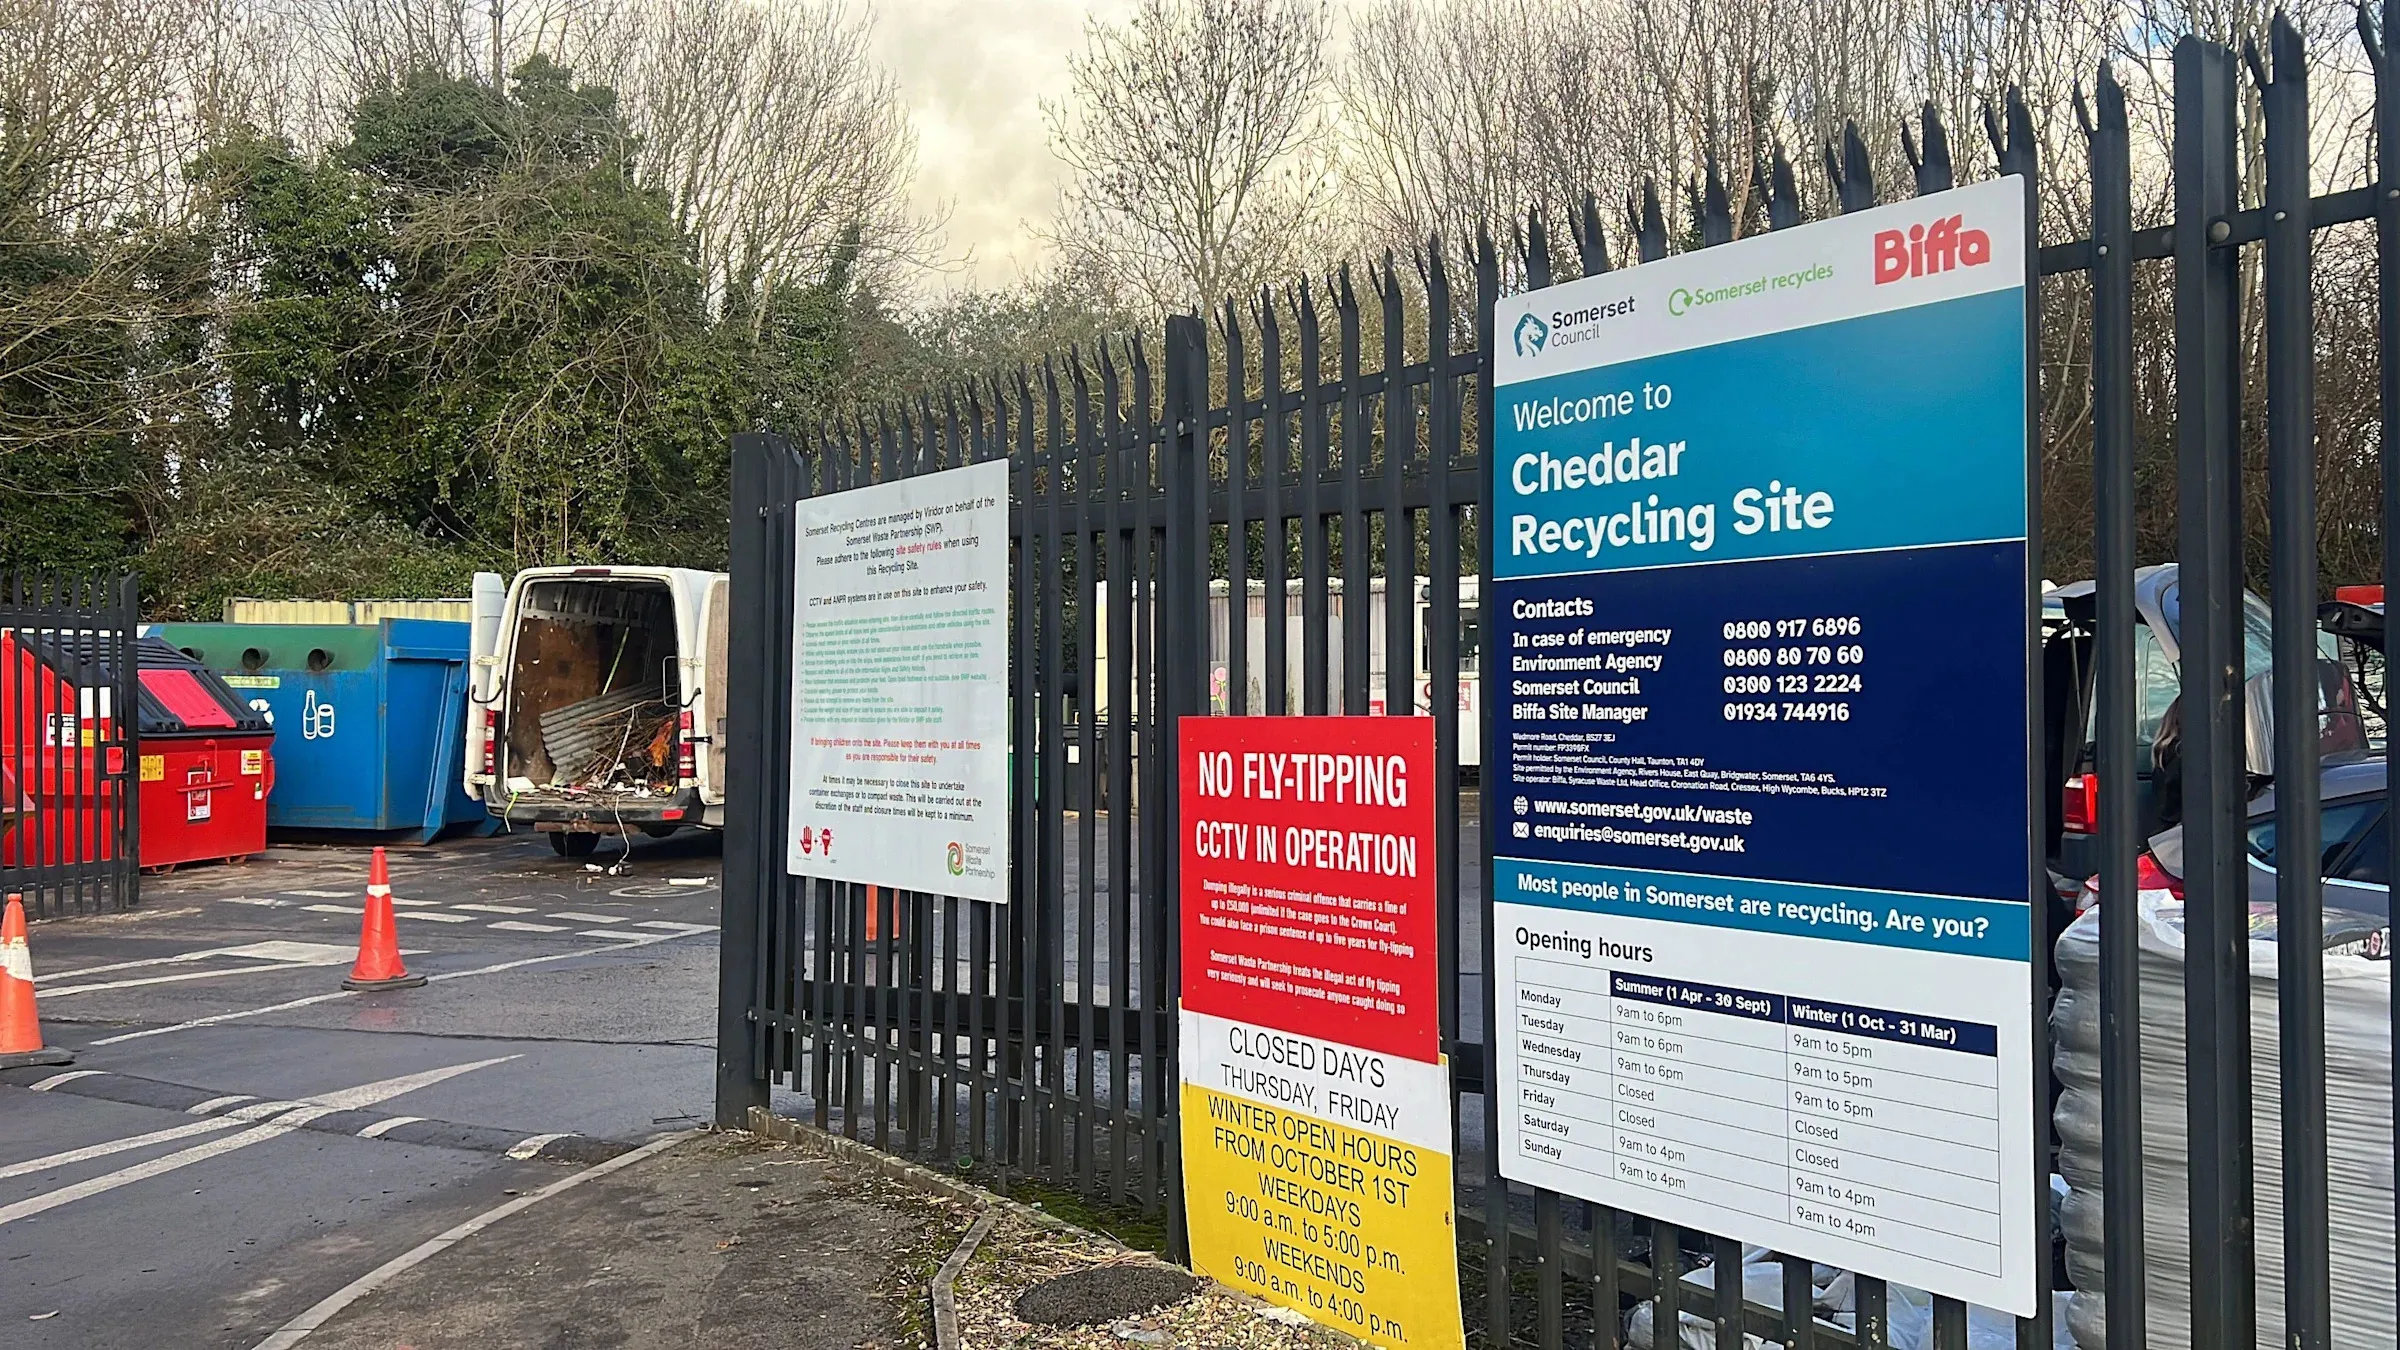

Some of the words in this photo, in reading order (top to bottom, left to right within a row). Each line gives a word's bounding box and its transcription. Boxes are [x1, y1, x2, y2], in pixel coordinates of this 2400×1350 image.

[1875, 214, 1990, 285] Biffa
[1695, 276, 1766, 305] Somerset
[1772, 263, 1833, 289] recycles
[1552, 296, 1634, 329] Somerset
[1551, 323, 1599, 347] Council
[1513, 391, 1633, 431] Welcome
[1643, 382, 1671, 410] to
[1512, 438, 1684, 494] Cheddar
[805, 525, 828, 537] Somerset
[830, 521, 854, 533] Recycling
[855, 518, 877, 528] Centres
[877, 516, 888, 525] are
[888, 510, 913, 523] managed
[913, 509, 922, 520] by
[923, 506, 945, 517] Viridor
[945, 505, 954, 514] on
[955, 498, 974, 512] behalf
[976, 497, 984, 508] of
[984, 497, 994, 507] the
[1512, 495, 1714, 557] Recycling
[1733, 480, 1833, 534] Site
[1512, 597, 1593, 619] Contacts
[1512, 632, 1528, 647] In
[1531, 633, 1564, 647] case
[1568, 628, 1584, 645] of
[1587, 629, 1671, 647] emergency
[1723, 621, 1771, 639] 0800
[1776, 619, 1806, 637] 917
[1812, 616, 1860, 636] 6896
[1512, 654, 1601, 671] Environment
[1605, 653, 1661, 673] Agency
[1723, 648, 1771, 666] 0800
[1776, 647, 1801, 665] 80
[1806, 646, 1831, 664] 70
[1837, 645, 1863, 664] 60
[1512, 680, 1579, 695] Somerset
[1583, 676, 1639, 694] Council
[1723, 675, 1771, 693] 0300
[1776, 675, 1807, 693] 123
[1814, 674, 1861, 692] 2224
[1512, 702, 1545, 719] Biffa
[1549, 702, 1578, 719] Site
[1582, 703, 1647, 724] Manager
[1723, 703, 1777, 720] 01934
[1782, 703, 1849, 721] 744916
[822, 775, 827, 783] At
[846, 777, 855, 786] may
[856, 777, 862, 785] be
[863, 778, 888, 788] necessary
[910, 779, 920, 788] this
[921, 780, 930, 789] site
[931, 781, 936, 789] to
[938, 782, 964, 791] undertake
[1199, 751, 1232, 797] NO
[1243, 753, 1406, 806] FLY-TIPPING
[1512, 773, 1525, 782] Site
[1568, 775, 1595, 785] Syracuse
[1629, 778, 1647, 787] Head
[1670, 780, 1708, 789] Coronation
[1709, 781, 1729, 791] Road,
[1730, 782, 1761, 792] Cressex,
[1762, 783, 1780, 794] High
[1781, 784, 1820, 795] Wycombe,
[1821, 786, 1847, 796] Bucks,
[1847, 787, 1869, 796] HP12
[1870, 787, 1887, 797] 3TZ
[1534, 801, 1751, 824] www.somerset.gov.uk/waste
[965, 842, 991, 855] Somerset
[1196, 820, 1247, 860] CCTV
[1256, 825, 1276, 863] IN
[1285, 827, 1415, 876] OPERATION
[1534, 823, 1744, 852] enquiries@somerset.gov.uk
[965, 855, 982, 866] Waste
[965, 866, 995, 880] Partnership
[1518, 873, 1557, 893] Most
[1562, 881, 1618, 901] people
[1623, 881, 1640, 902] in
[1646, 886, 1733, 912] Somerset
[1740, 899, 1771, 916] are
[1778, 902, 1878, 931] recycling.
[1885, 909, 1925, 932] Are
[1932, 917, 1988, 938] you?
[1515, 927, 1591, 959] Opening
[1599, 937, 1652, 962] hours
[1210, 949, 1237, 964] Somerset
[1237, 954, 1256, 968] Waste
[1257, 957, 1291, 976] Partnership
[1292, 964, 1311, 978] treats
[1312, 967, 1323, 980] the
[1324, 969, 1344, 985] illegal
[1345, 974, 1356, 986] act
[1357, 975, 1364, 987] of
[1365, 976, 1375, 992] fly
[1376, 978, 1400, 996] tipping
[1521, 989, 1560, 1008] Monday
[1615, 978, 1663, 996] Summer
[1666, 985, 1676, 1001] (1
[1680, 988, 1702, 1004] Apr
[1715, 993, 1732, 1007] 30
[1735, 996, 1770, 1016] Sept)
[1521, 1014, 1563, 1033] Tuesday
[1616, 1004, 1639, 1019] 9am
[1643, 1010, 1654, 1021] to
[1657, 1011, 1682, 1026] 6pm
[1792, 1004, 1838, 1023] Winter
[1841, 1011, 1854, 1028] (1
[1858, 1014, 1885, 1031] Oct
[1899, 1020, 1916, 1036] 31
[1921, 1023, 1956, 1044] Mar)
[1229, 1027, 1314, 1070] CLOSED
[1323, 1047, 1384, 1087] DAYS
[1522, 1039, 1580, 1062] Wednesday
[1793, 1033, 1821, 1049] 9am
[1825, 1039, 1838, 1052] to
[1843, 1041, 1871, 1058] 5pm
[1522, 1064, 1569, 1085] Thursday
[1221, 1063, 1316, 1112] THURSDAY,
[1329, 1091, 1398, 1130] FRIDAY
[1523, 1089, 1554, 1107] Friday
[1208, 1095, 1276, 1135] WINTER
[1283, 1116, 1335, 1153] OPEN
[1342, 1132, 1416, 1176] HOURS
[1524, 1114, 1569, 1136] Saturday
[1524, 1139, 1561, 1159] Sunday
[1215, 1126, 1264, 1163] FROM
[1271, 1144, 1364, 1195] OCTOBER
[1373, 1175, 1409, 1208] 1ST
[1258, 1172, 1360, 1227] WEEKDAYS
[1226, 1191, 1258, 1221] 9:00
[1264, 1209, 1297, 1235] a.m.
[1302, 1217, 1317, 1242] to
[1324, 1224, 1359, 1257] 5:00
[1366, 1245, 1404, 1274] p.m.
[1263, 1236, 1364, 1293] WEEKENDS
[1234, 1256, 1265, 1285] 9:00
[1271, 1275, 1302, 1301] a.m.
[1307, 1285, 1322, 1309] to
[1328, 1293, 1363, 1325] 4:00
[1371, 1313, 1408, 1342] p.m.
